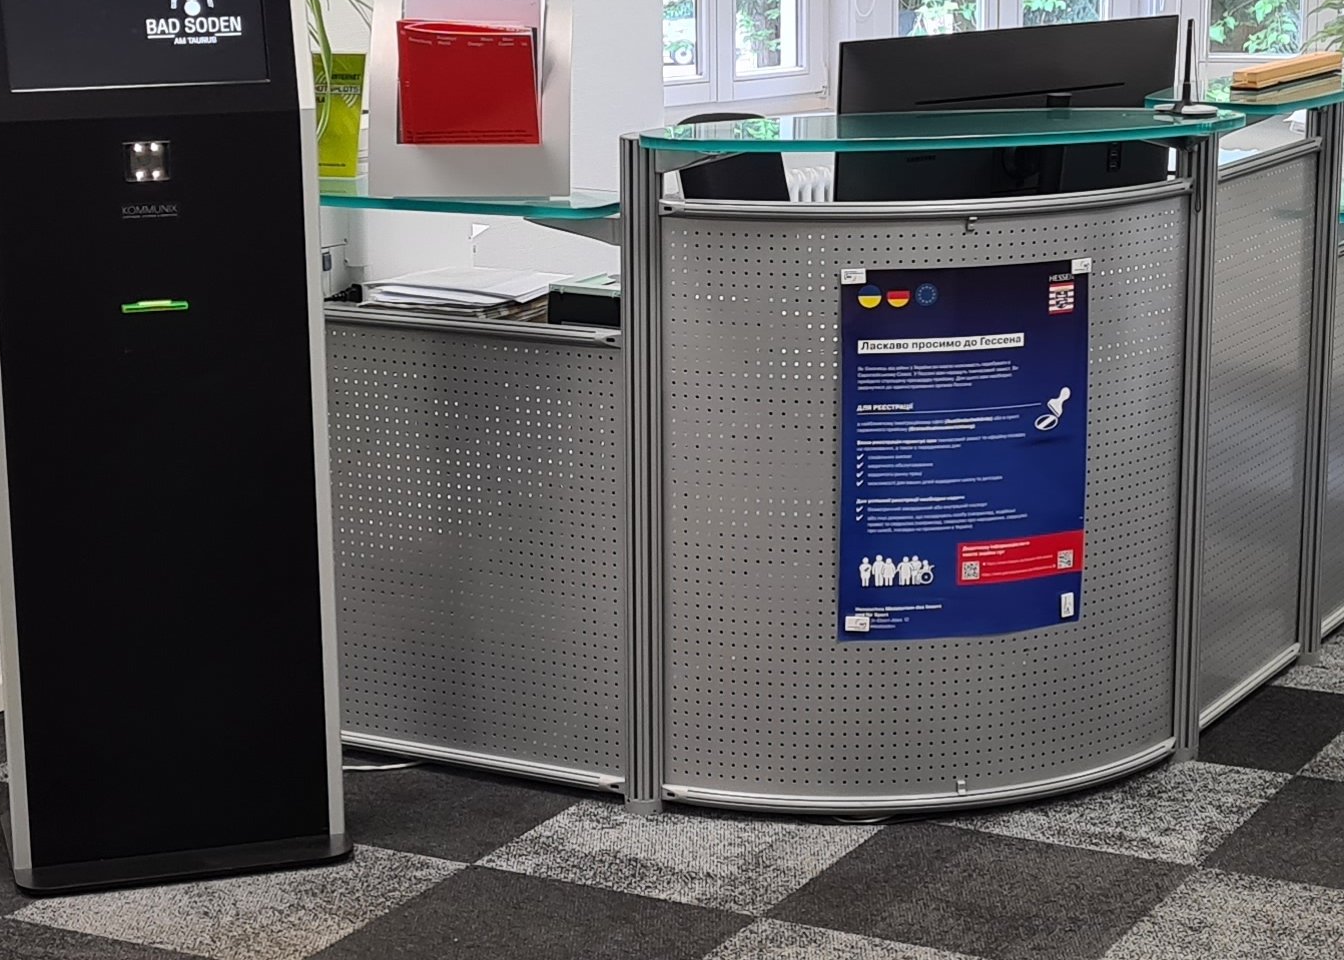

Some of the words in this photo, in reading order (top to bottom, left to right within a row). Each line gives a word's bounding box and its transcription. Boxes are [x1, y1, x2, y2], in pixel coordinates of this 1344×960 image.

[145, 18, 180, 35] BAD
[183, 15, 242, 34] SODEN
[860, 341, 909, 351] Ласкаво
[911, 340, 962, 351] просимо
[963, 340, 977, 348] до
[980, 335, 1022, 346] Гессена
